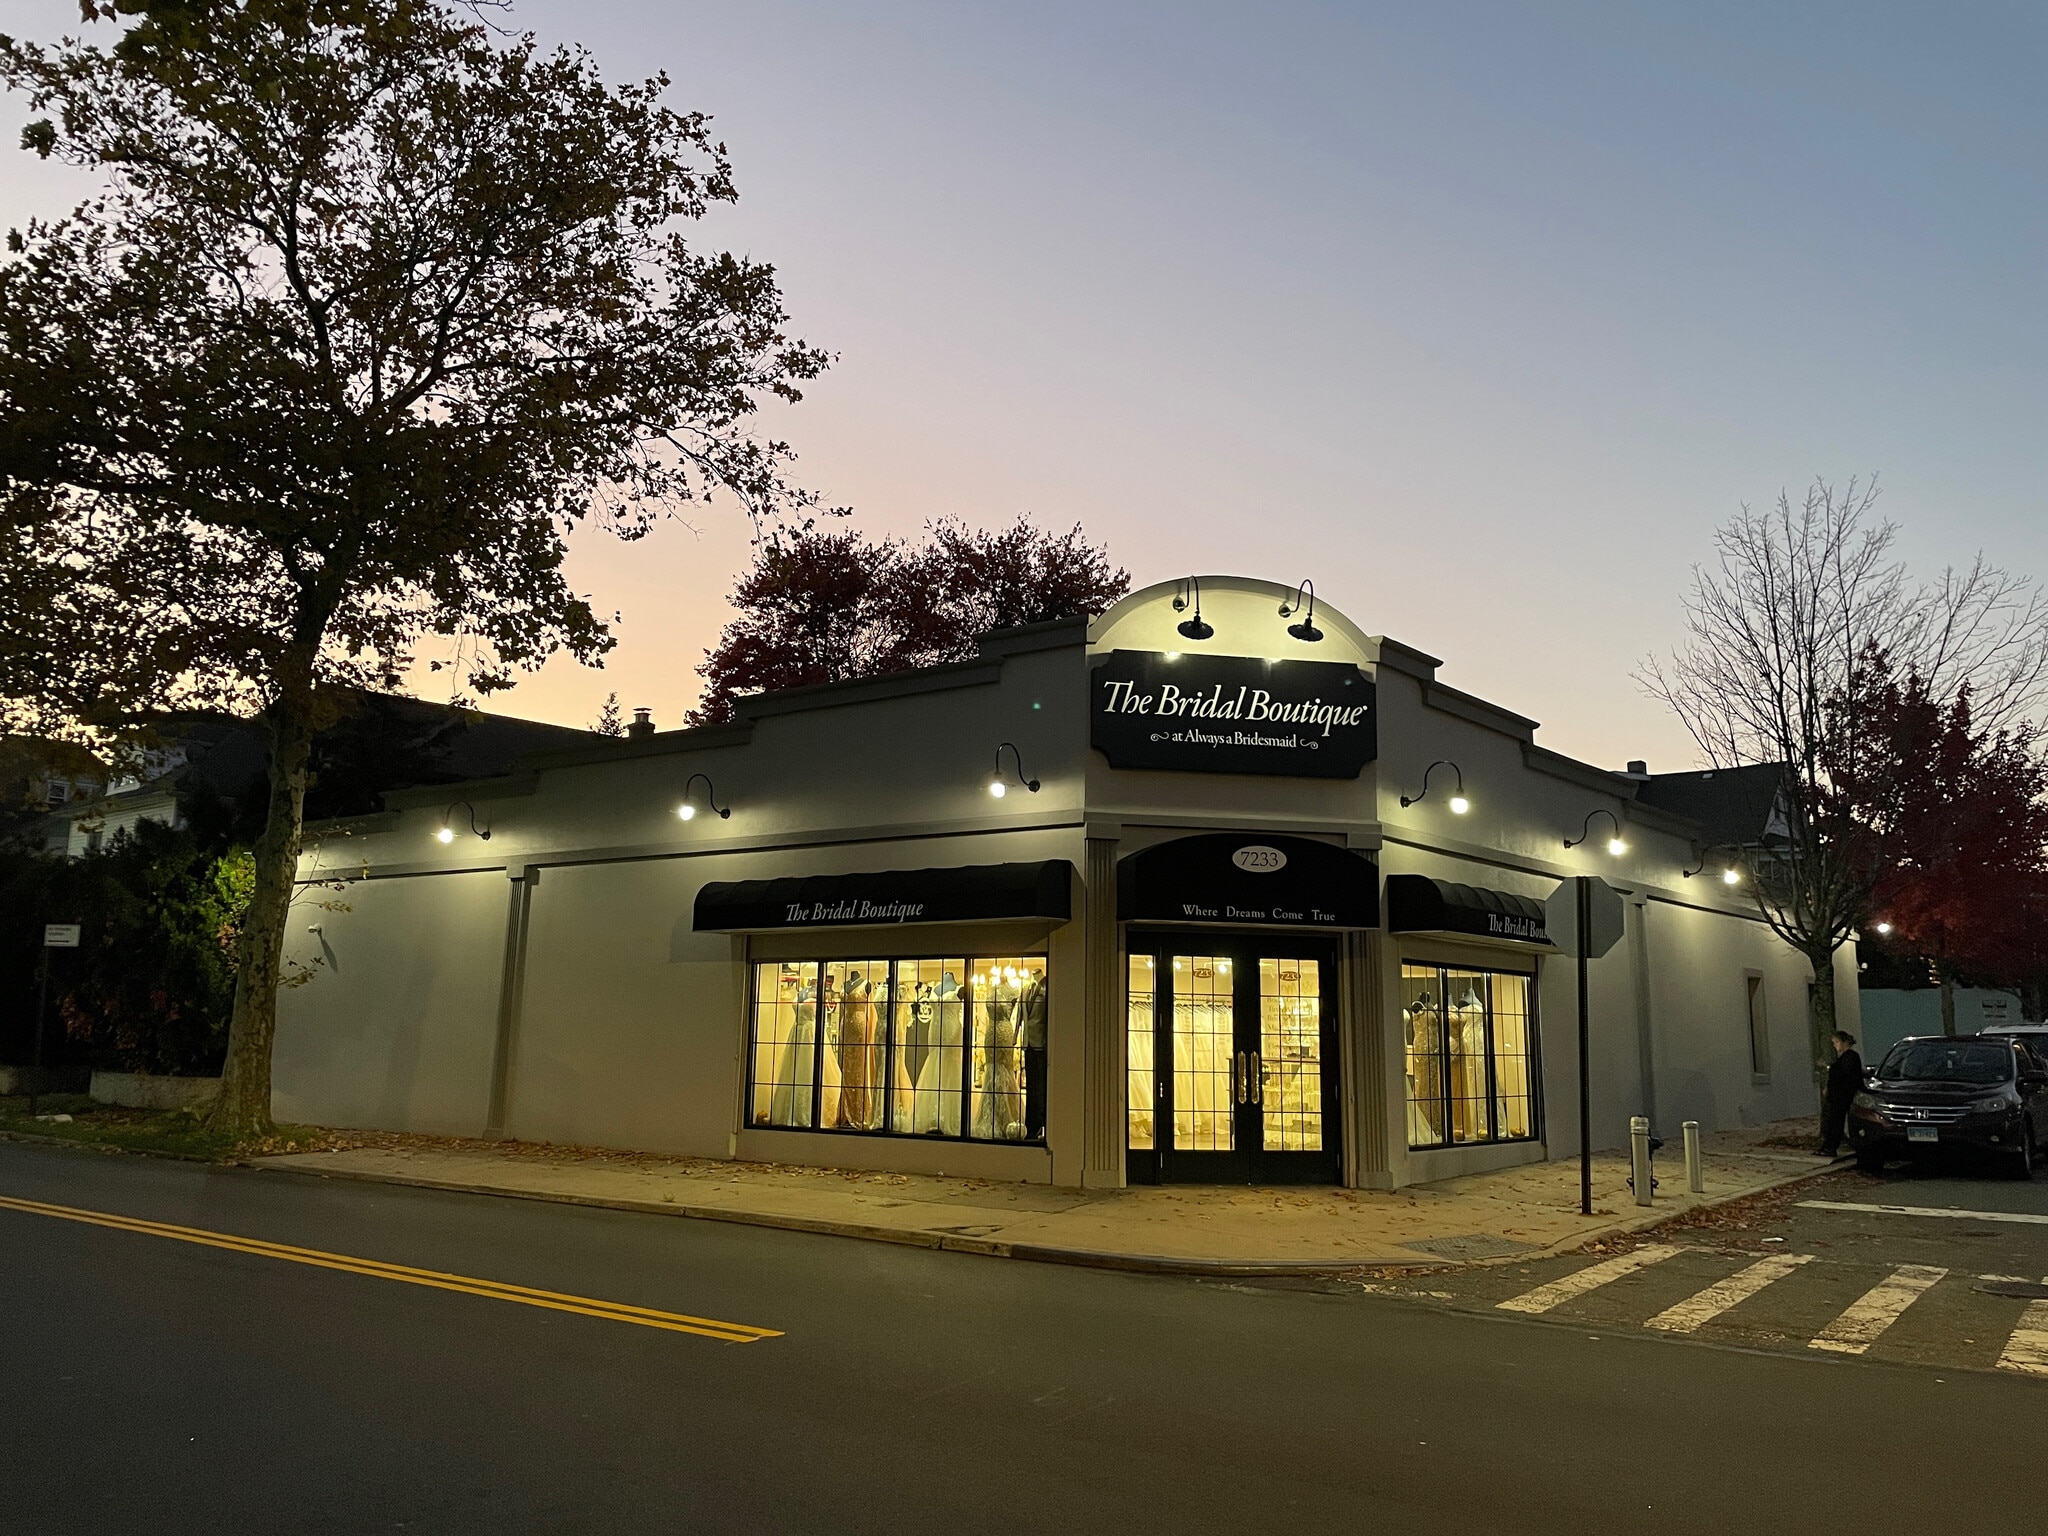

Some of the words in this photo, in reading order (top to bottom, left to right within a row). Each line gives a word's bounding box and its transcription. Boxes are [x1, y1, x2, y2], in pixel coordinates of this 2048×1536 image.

[1103, 680, 1153, 715] The
[1154, 684, 1248, 720] Bridal
[1245, 689, 1365, 737] Boutique
[1172, 731, 1184, 742] at
[1184, 728, 1225, 748] Always
[1225, 735, 1232, 745] a
[1234, 732, 1297, 748] Bridesmaid
[1240, 851, 1279, 867] 7233
[786, 903, 809, 922] The
[811, 899, 858, 920] Bridal
[858, 900, 924, 923] Boutique
[1182, 903, 1218, 917] Where
[1226, 905, 1266, 918] Dreams
[1272, 907, 1304, 919] Come
[1311, 909, 1336, 921] True
[1488, 914, 1503, 932] The
[1504, 916, 1528, 936] Bridal
